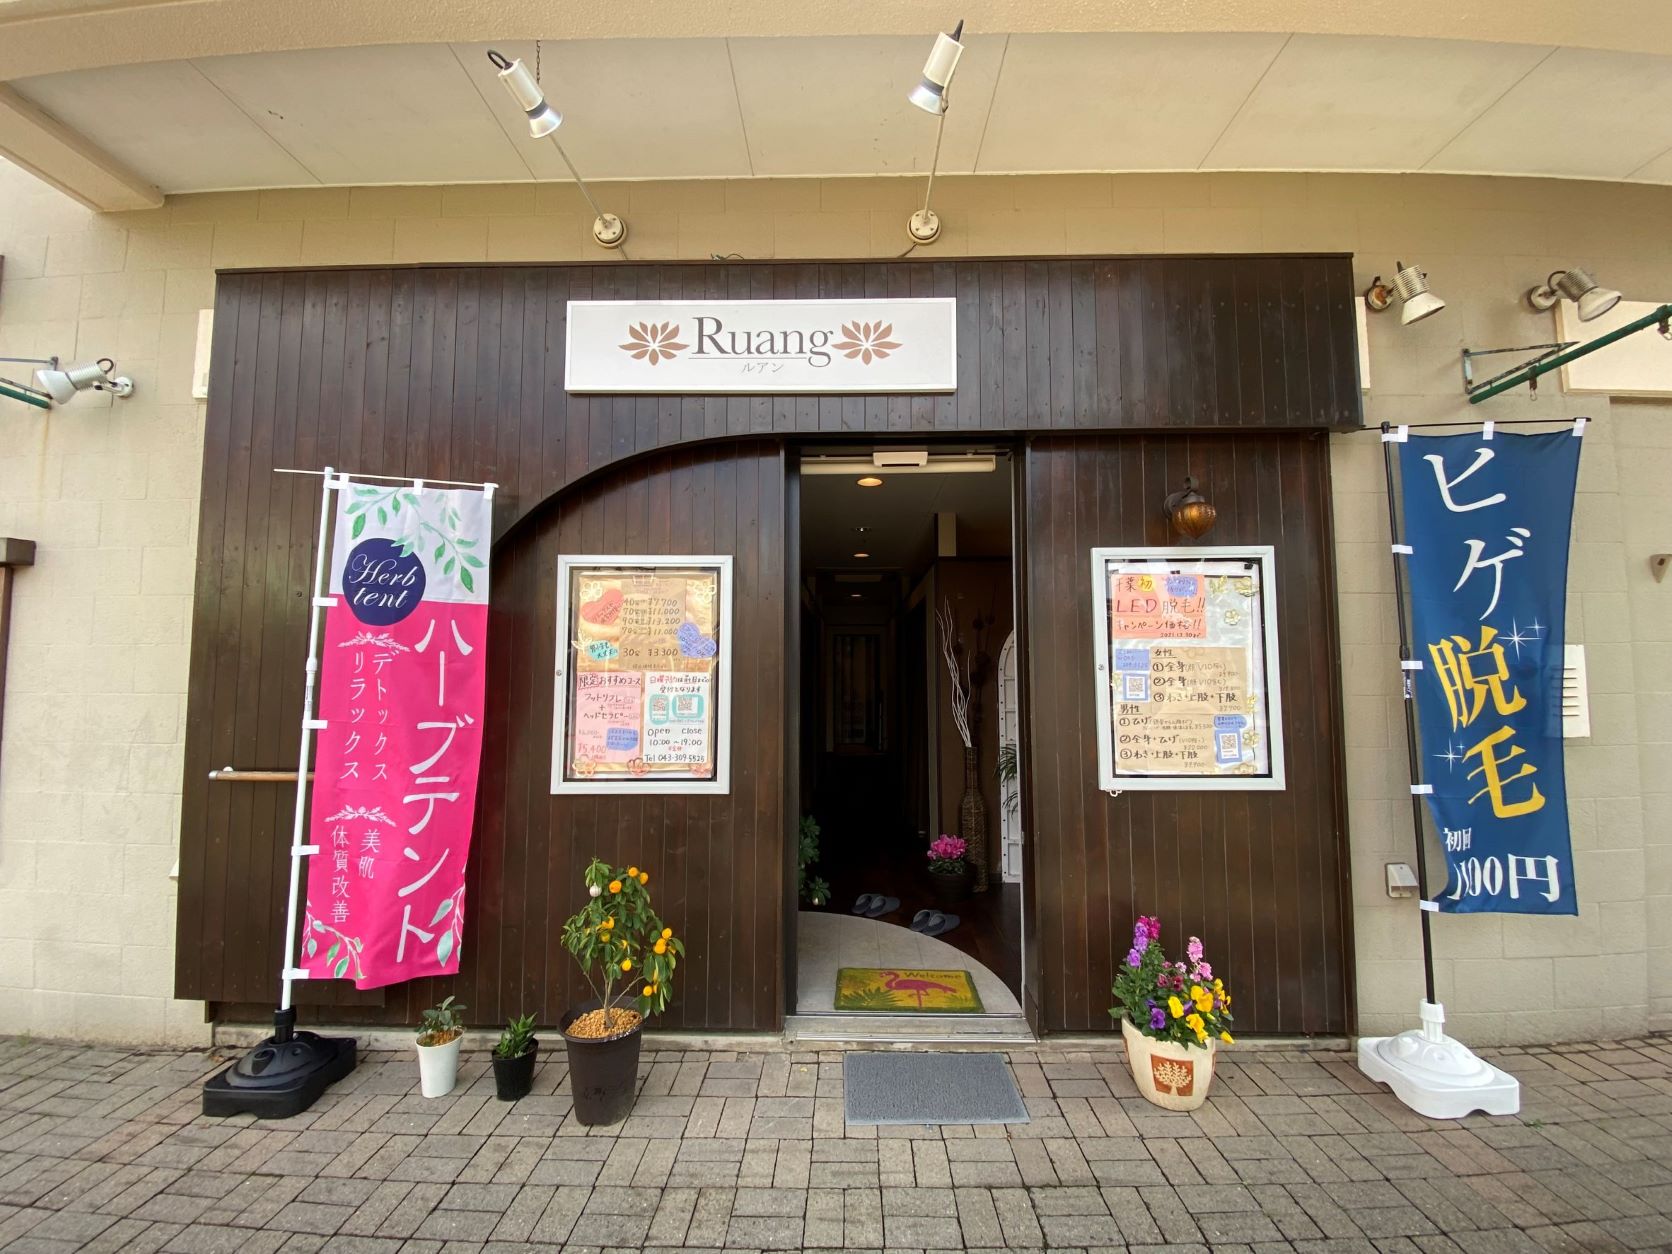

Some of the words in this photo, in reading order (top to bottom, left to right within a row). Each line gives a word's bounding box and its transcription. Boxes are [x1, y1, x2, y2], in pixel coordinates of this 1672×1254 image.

[691, 316, 833, 367] Ruang
[741, 361, 785, 374] ルアン
[348, 554, 418, 585] Herb
[353, 588, 408, 609] tent
[1116, 598, 1159, 613] LED
[1422, 447, 1546, 818] ヒゲ脱毛
[339, 651, 366, 780] リラックス
[371, 650, 399, 781] デトックス
[647, 728, 671, 738] Open
[396, 619, 474, 962] ハーブテント
[330, 825, 350, 923] 体質改善
[358, 829, 381, 879] 美肌
[903, 971, 962, 980] Welcome
